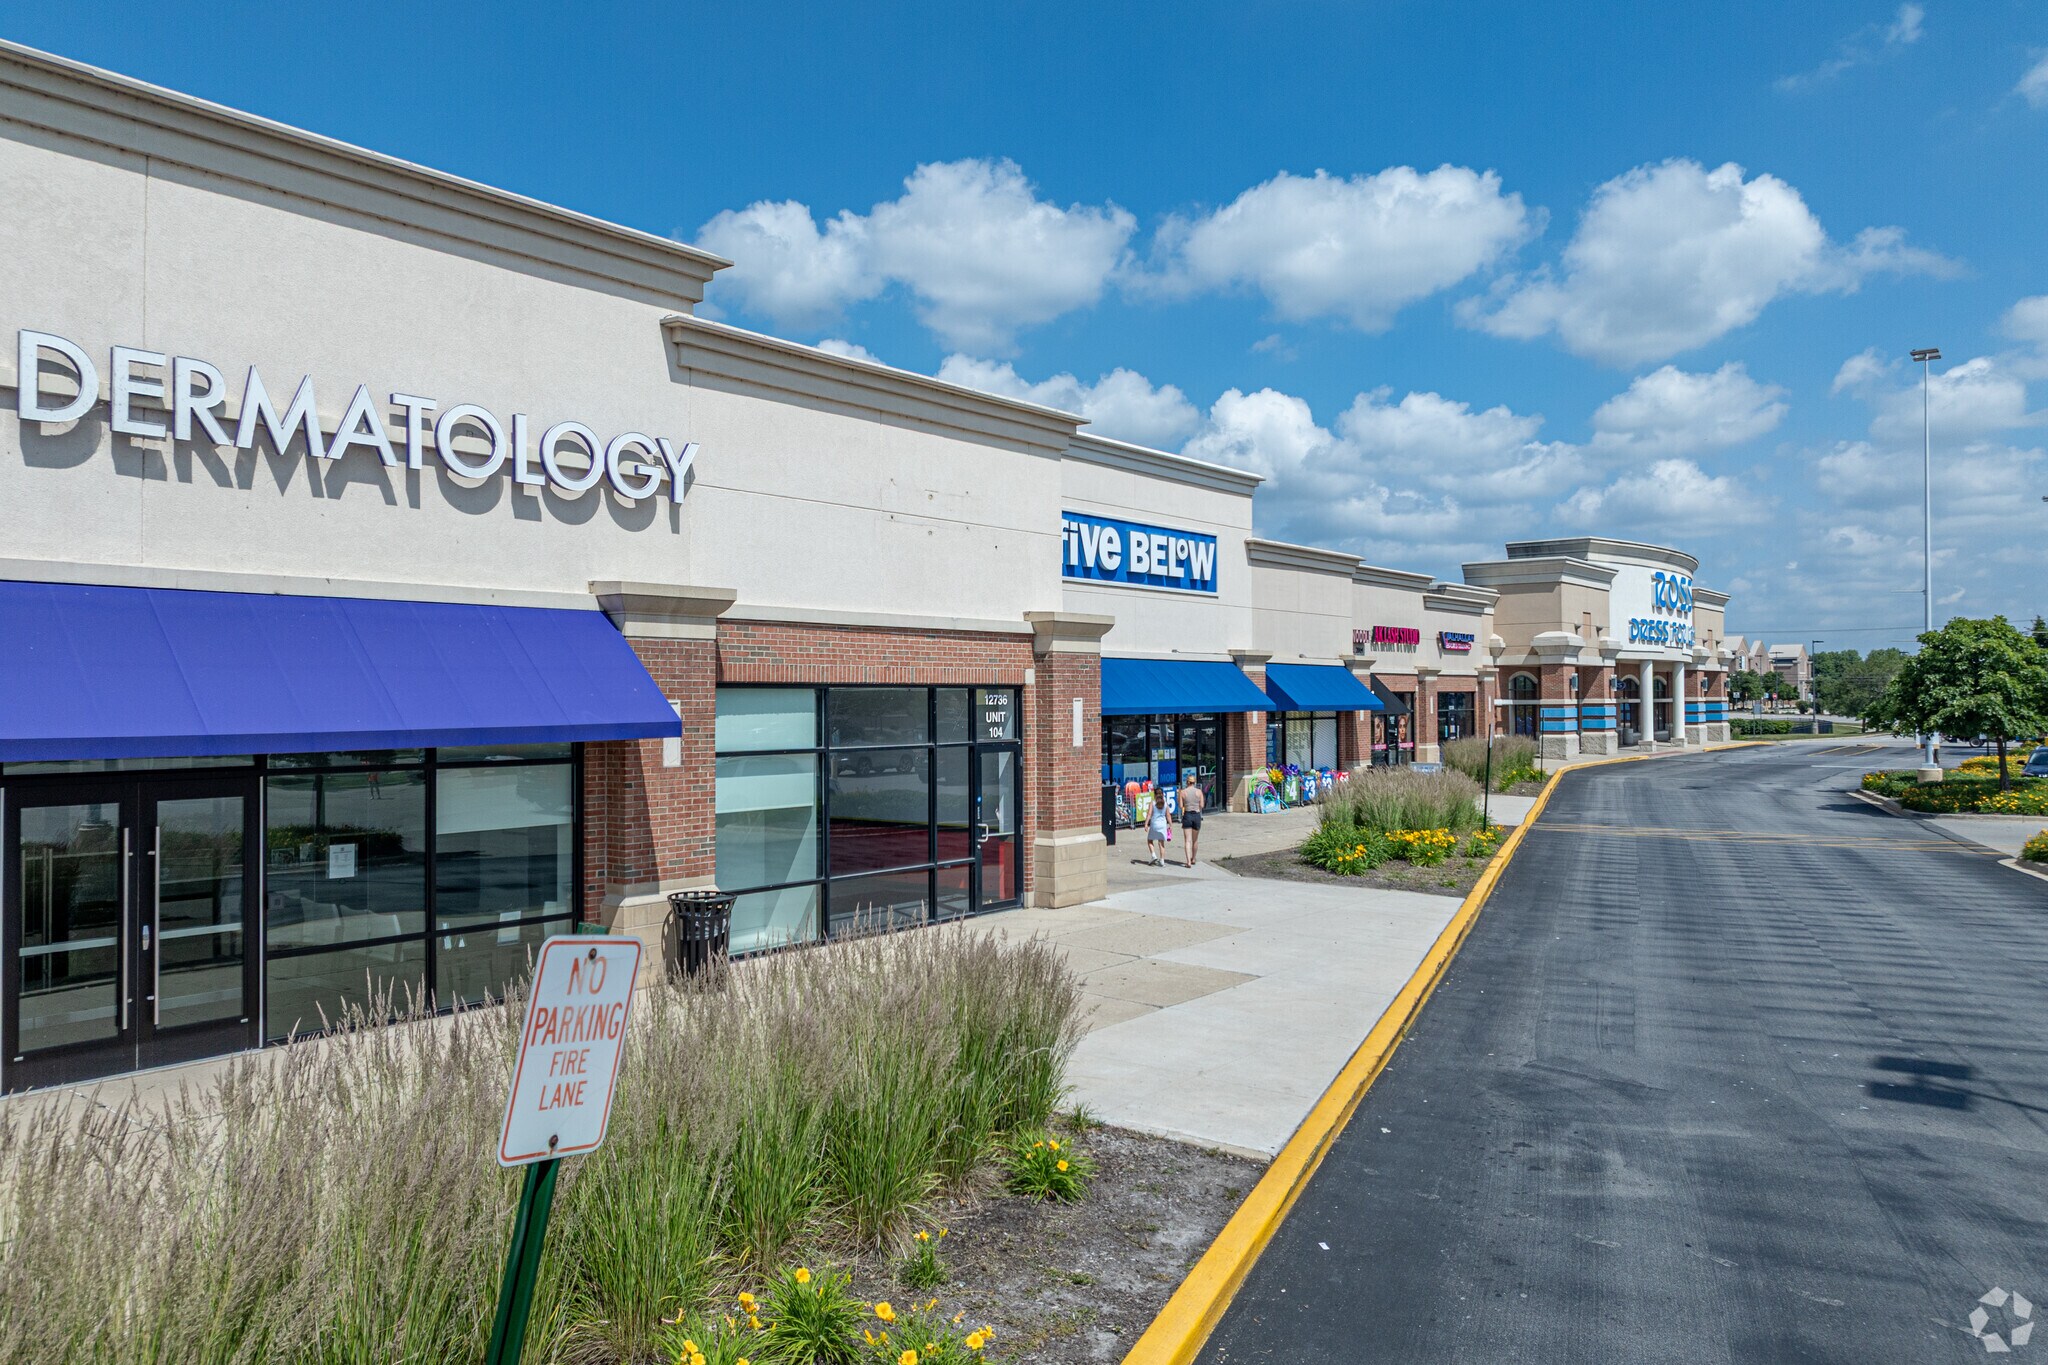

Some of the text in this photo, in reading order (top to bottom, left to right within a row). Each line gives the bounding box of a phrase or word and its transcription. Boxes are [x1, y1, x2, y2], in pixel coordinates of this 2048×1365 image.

[17, 328, 700, 505] DERMATOLOGY
[1653, 571, 1693, 613] ROSS
[1630, 617, 1669, 643] DRESS
[984, 694, 1008, 706] 12736
[985, 711, 1006, 723] UNIT
[988, 726, 1003, 738] 104
[566, 956, 608, 996] NO
[530, 1001, 623, 1047] PARKING
[548, 1047, 591, 1078] FIRE
[538, 1079, 588, 1112] LANE
